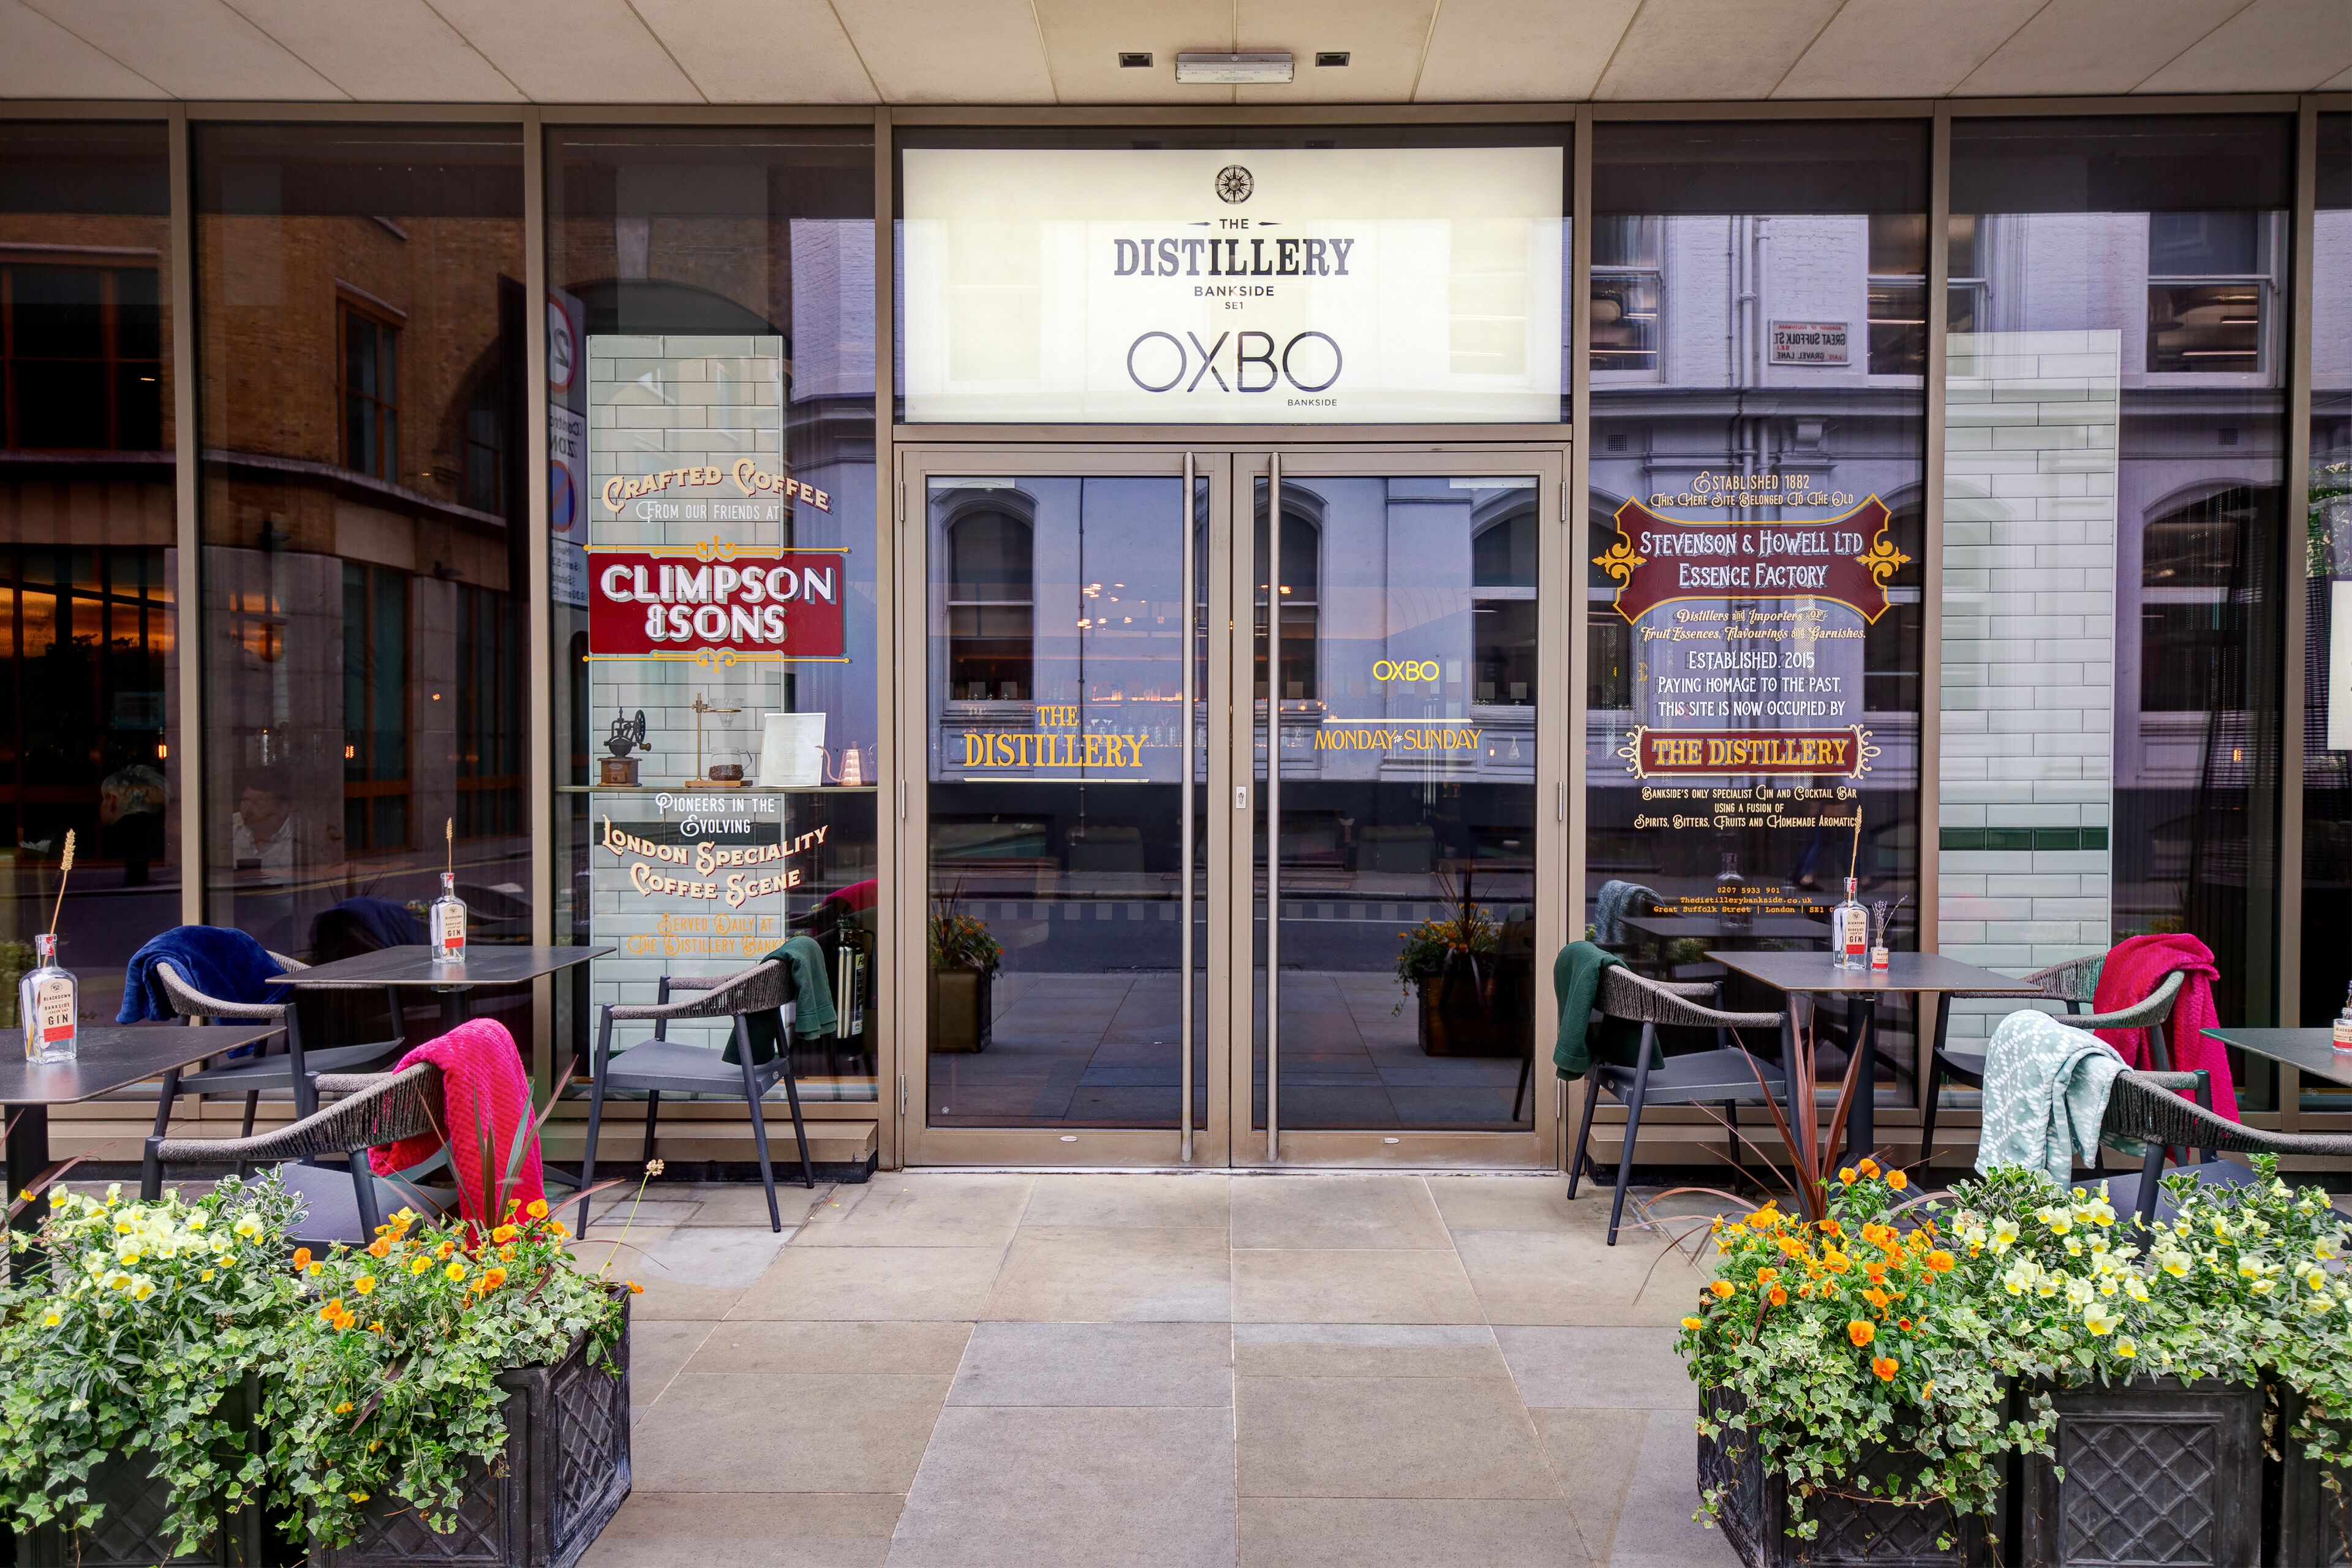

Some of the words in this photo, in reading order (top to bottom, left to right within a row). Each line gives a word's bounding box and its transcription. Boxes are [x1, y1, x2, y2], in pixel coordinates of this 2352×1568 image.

[1219, 219, 1249, 229] THE
[1114, 238, 1354, 276] DISTILLERY
[1194, 286, 1275, 297] BANKSIDE
[1127, 331, 1343, 393] OXBO
[601, 466, 723, 513] CRAFTED
[731, 458, 834, 513] COFFEE
[1694, 471, 1779, 494] ESTABLISHED
[1785, 475, 1809, 489] 1882
[1714, 492, 1735, 507] SITE
[1739, 492, 1783, 507] BELONGED
[686, 505, 706, 519] OUR
[714, 505, 760, 519] FRIENDS
[767, 505, 780, 519] AT
[1640, 532, 1738, 554] STEVENSON
[1742, 533, 1754, 551] &
[1759, 530, 1829, 557] HOWELL
[1834, 532, 1864, 554] LTD
[601, 565, 837, 605] CLIMPSON
[1679, 564, 1749, 587] ESSENCE
[1755, 564, 1829, 587] FACTORY
[1676, 609, 1728, 624] Distillers
[1732, 611, 1745, 621] and
[1749, 609, 1803, 624] Importers
[1641, 627, 1670, 641] Fruit
[1672, 627, 1721, 641] Essences,
[1724, 627, 1787, 641] Flavourings
[1792, 627, 1804, 638] and
[1809, 627, 1866, 640] Garnishes.
[1689, 650, 1781, 671] ESTABLISHED.
[1785, 652, 1815, 668] 2015
[1373, 660, 1439, 682] OXBO
[1657, 676, 1702, 695] PAYING
[1706, 677, 1757, 692] HOMAGE
[1761, 677, 1777, 692] TO
[1781, 677, 1804, 692] THE
[1809, 677, 1842, 693] PAST,
[1036, 706, 1080, 726] THE
[1658, 701, 1684, 716] THIS
[1689, 701, 1714, 716] SITE
[1718, 701, 1728, 716] IS
[1733, 701, 1762, 716] NOW
[1767, 701, 1825, 716] OCCUPIED
[1830, 701, 1846, 716] BY
[1314, 729, 1397, 750] MONDAY
[1404, 728, 1482, 750] SUNDAY
[963, 734, 1150, 767] DISTILLERY
[1652, 739, 1703, 766] THE
[1708, 739, 1850, 766] DISTILLERY
[1692, 789, 1708, 799] ONLY
[1713, 788, 1752, 799] SPECIALIST
[1755, 785, 1773, 801] GIN
[1777, 788, 1791, 798] AND
[1794, 786, 1833, 801] COCKTAIL
[1837, 786, 1856, 800] BAR
[732, 799, 744, 812] IN
[752, 798, 775, 812] THE
[1715, 802, 1735, 813] USING
[1740, 802, 1743, 813] A
[1747, 802, 1771, 813] FUSION
[1775, 802, 1784, 813] OF
[1749, 817, 1763, 827] AND
[602, 814, 688, 865] LONDON
[695, 825, 829, 877] SPECIALITY
[630, 862, 718, 900] COFFEE
[726, 870, 801, 909] SCENE
[760, 918, 773, 932] AT
[48, 1014, 69, 1025] GIN
